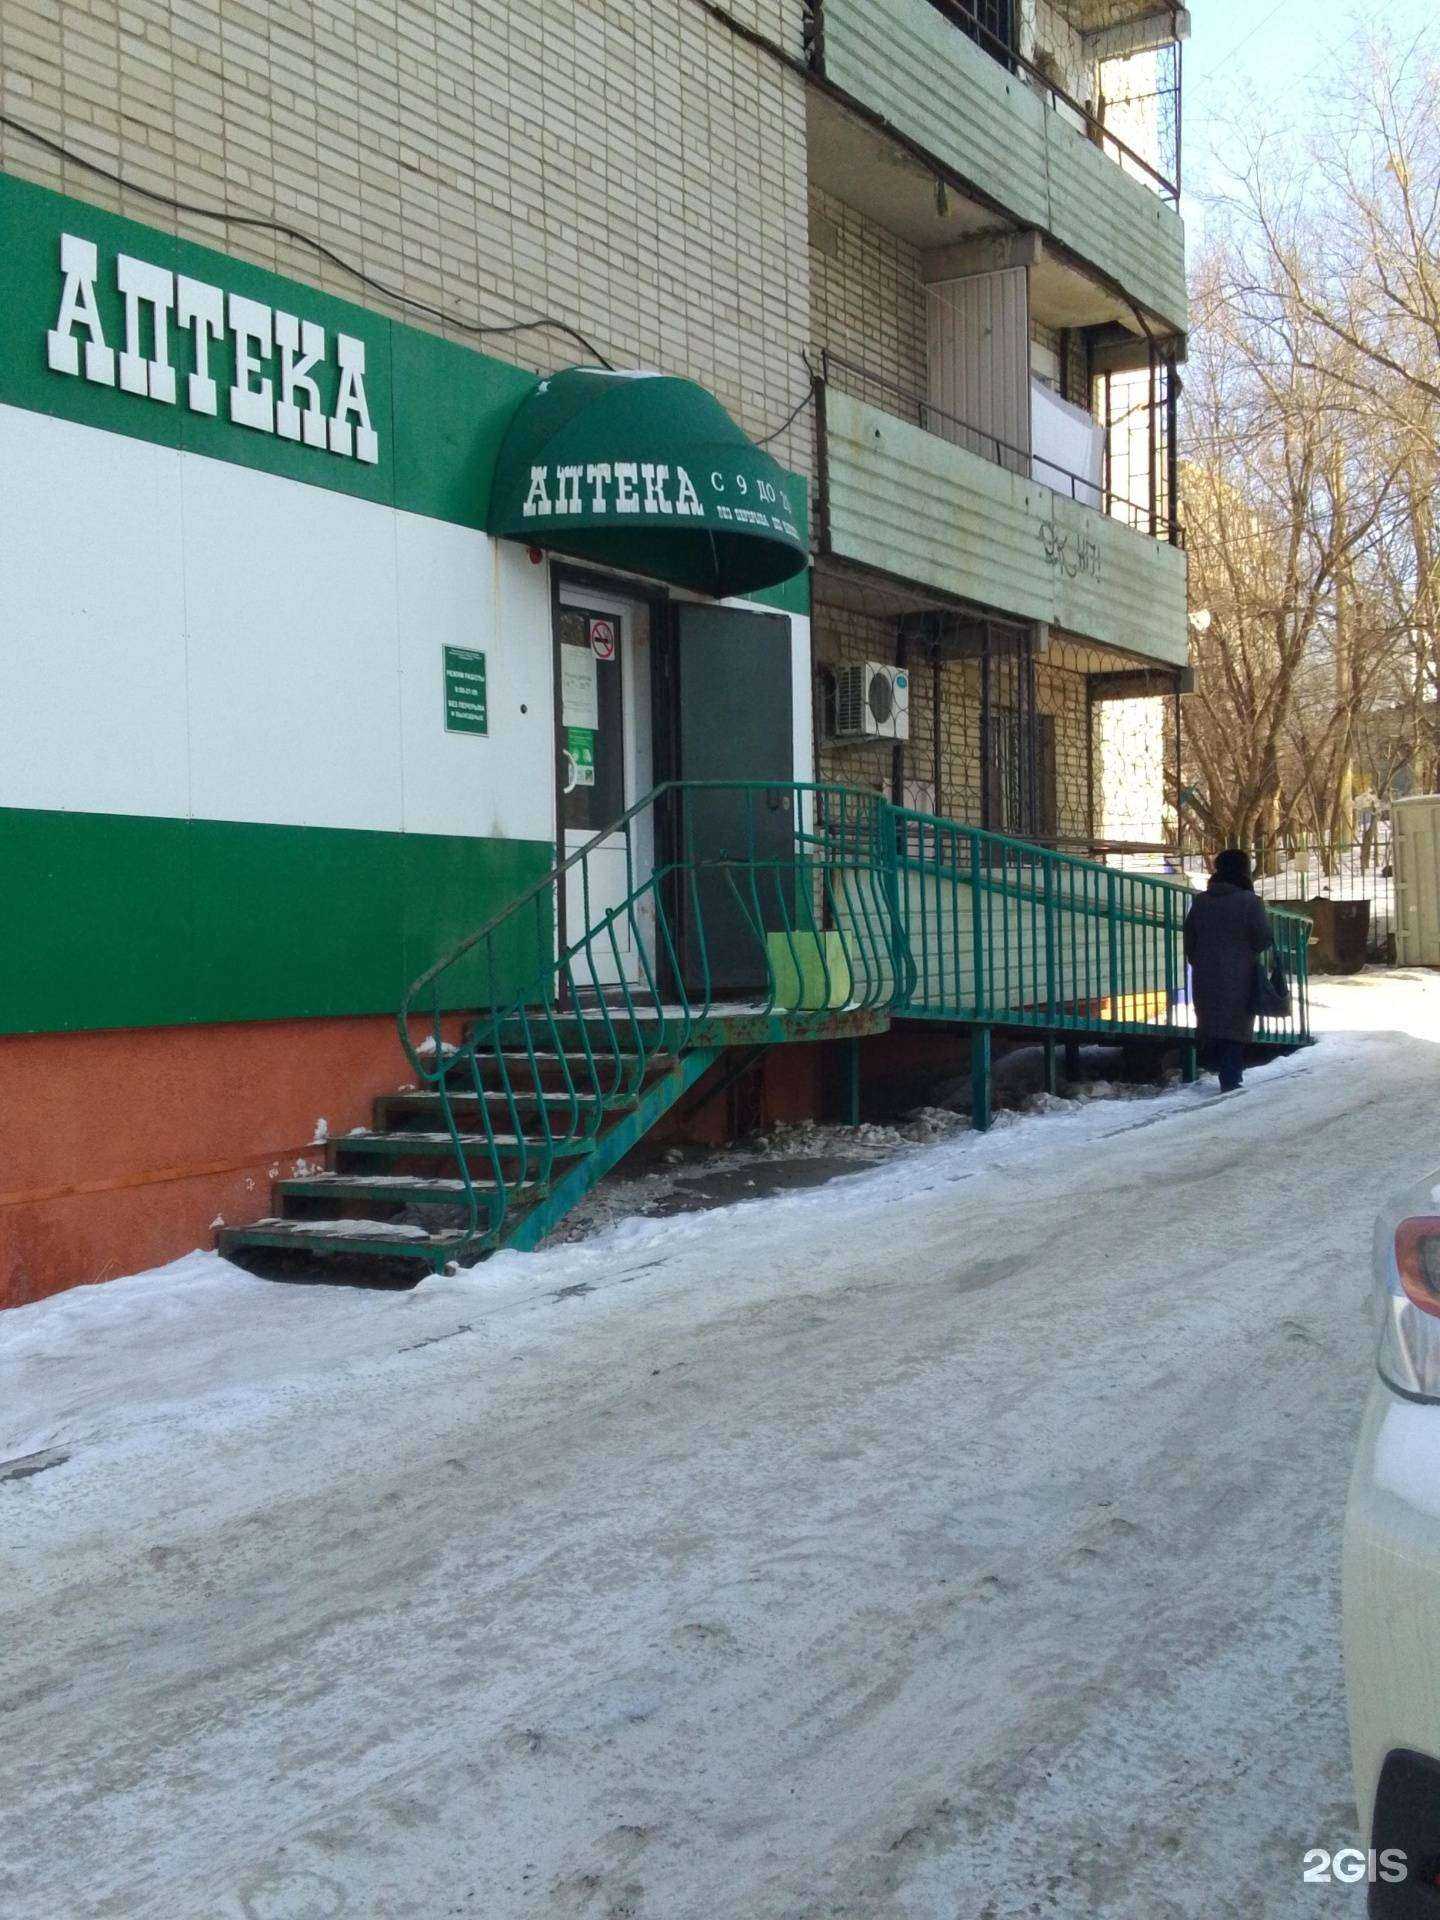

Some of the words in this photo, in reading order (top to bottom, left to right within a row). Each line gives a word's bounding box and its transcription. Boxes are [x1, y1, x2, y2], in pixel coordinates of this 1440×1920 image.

[47, 233, 379, 464] АПТЕКА
[523, 462, 704, 516] АПТЕКА
[736, 474, 748, 495] 9
